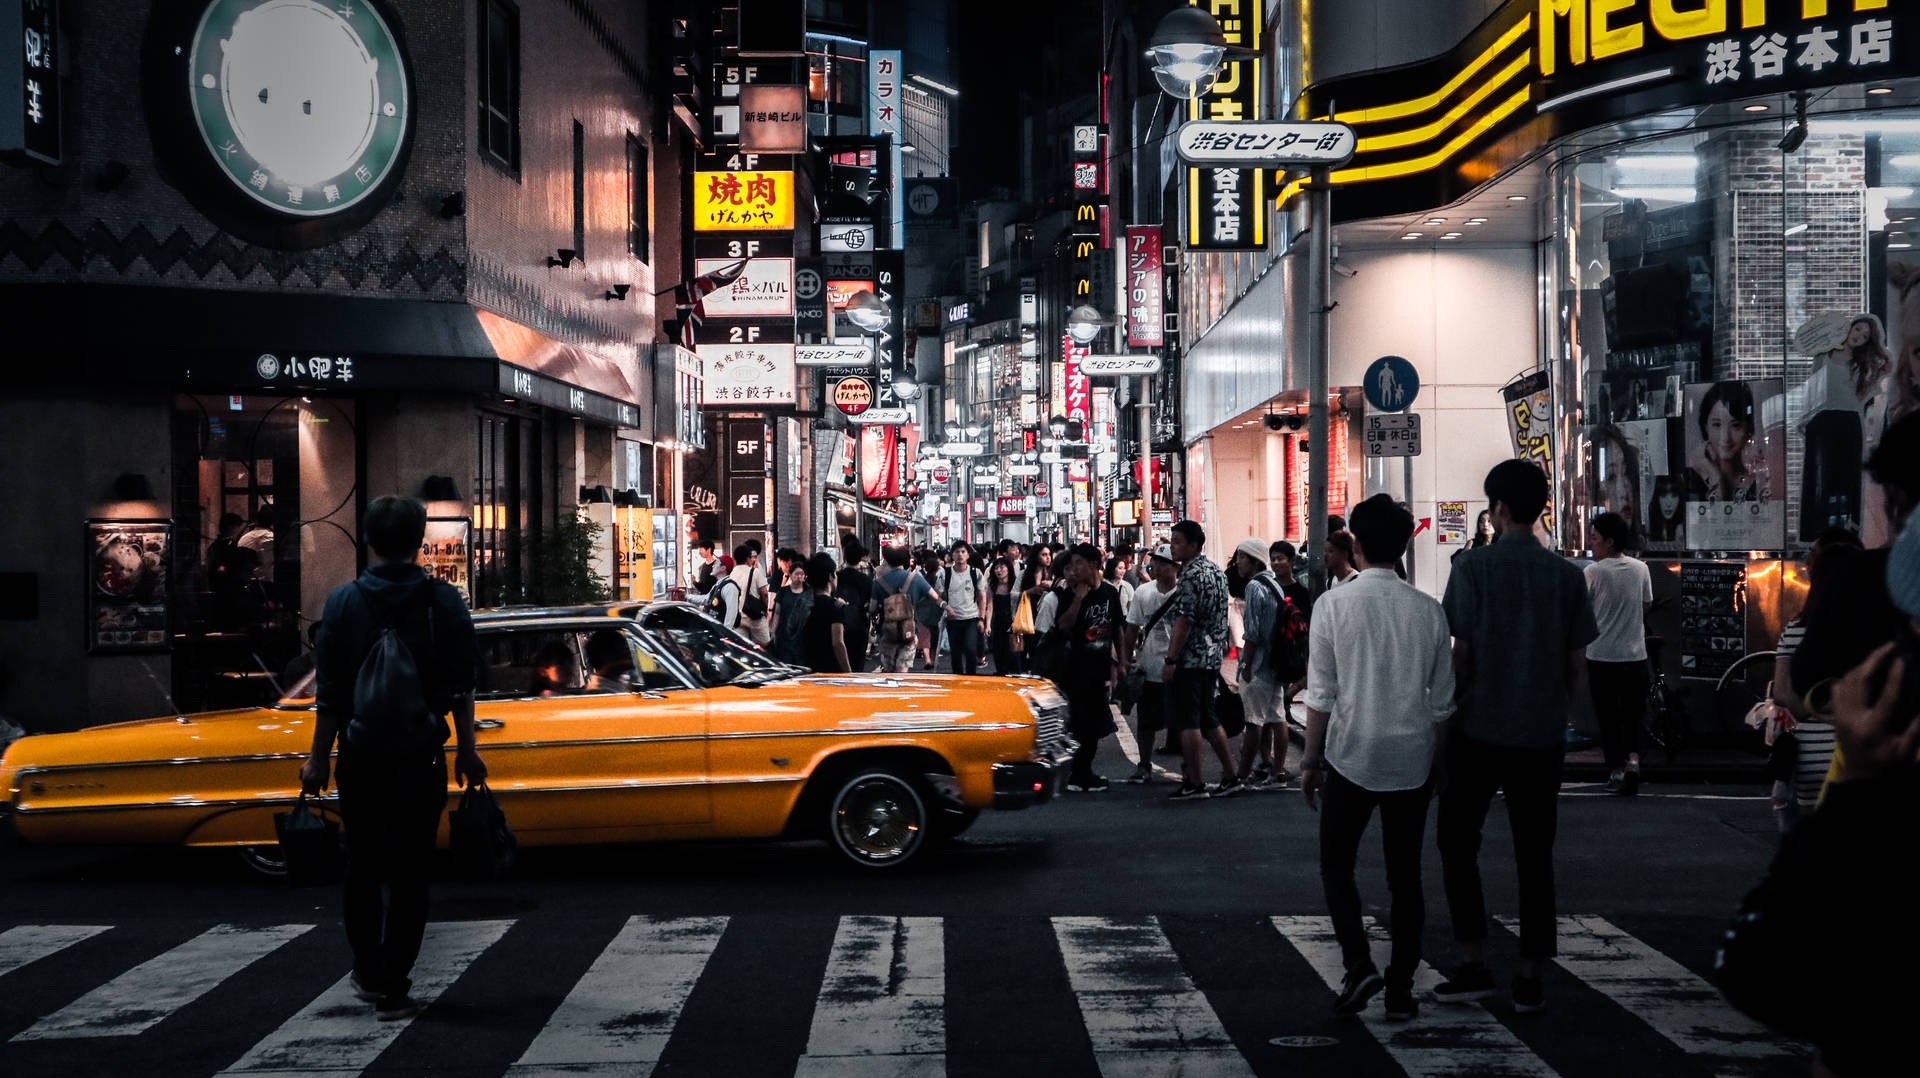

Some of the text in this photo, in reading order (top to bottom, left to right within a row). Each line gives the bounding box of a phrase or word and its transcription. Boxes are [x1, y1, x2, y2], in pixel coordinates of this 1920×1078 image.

[1706, 19, 1894, 85] 渋谷本店
[726, 67, 758, 83] 5F
[744, 112, 802, 123] 新岩崎ビル
[1189, 132, 1345, 150] 渋谷センター街
[726, 154, 759, 170] 4F
[708, 173, 777, 206] 焼肉
[1213, 168, 1240, 241] 谷本店
[710, 209, 774, 224] げんかや
[728, 241, 760, 257] 3F
[1131, 235, 1148, 323] アジアの味
[730, 327, 760, 343] 2F
[283, 356, 354, 382] 小肥羊
[1086, 359, 1156, 369] 渋谷センター街
[715, 386, 775, 400] 渋谷餃子
[1370, 417, 1381, 428] 15
[1407, 416, 1415, 427] 5
[736, 440, 759, 454] 5F
[1370, 444, 1382, 454] 12
[1408, 443, 1415, 453] 5
[736, 494, 759, 508] 4F
